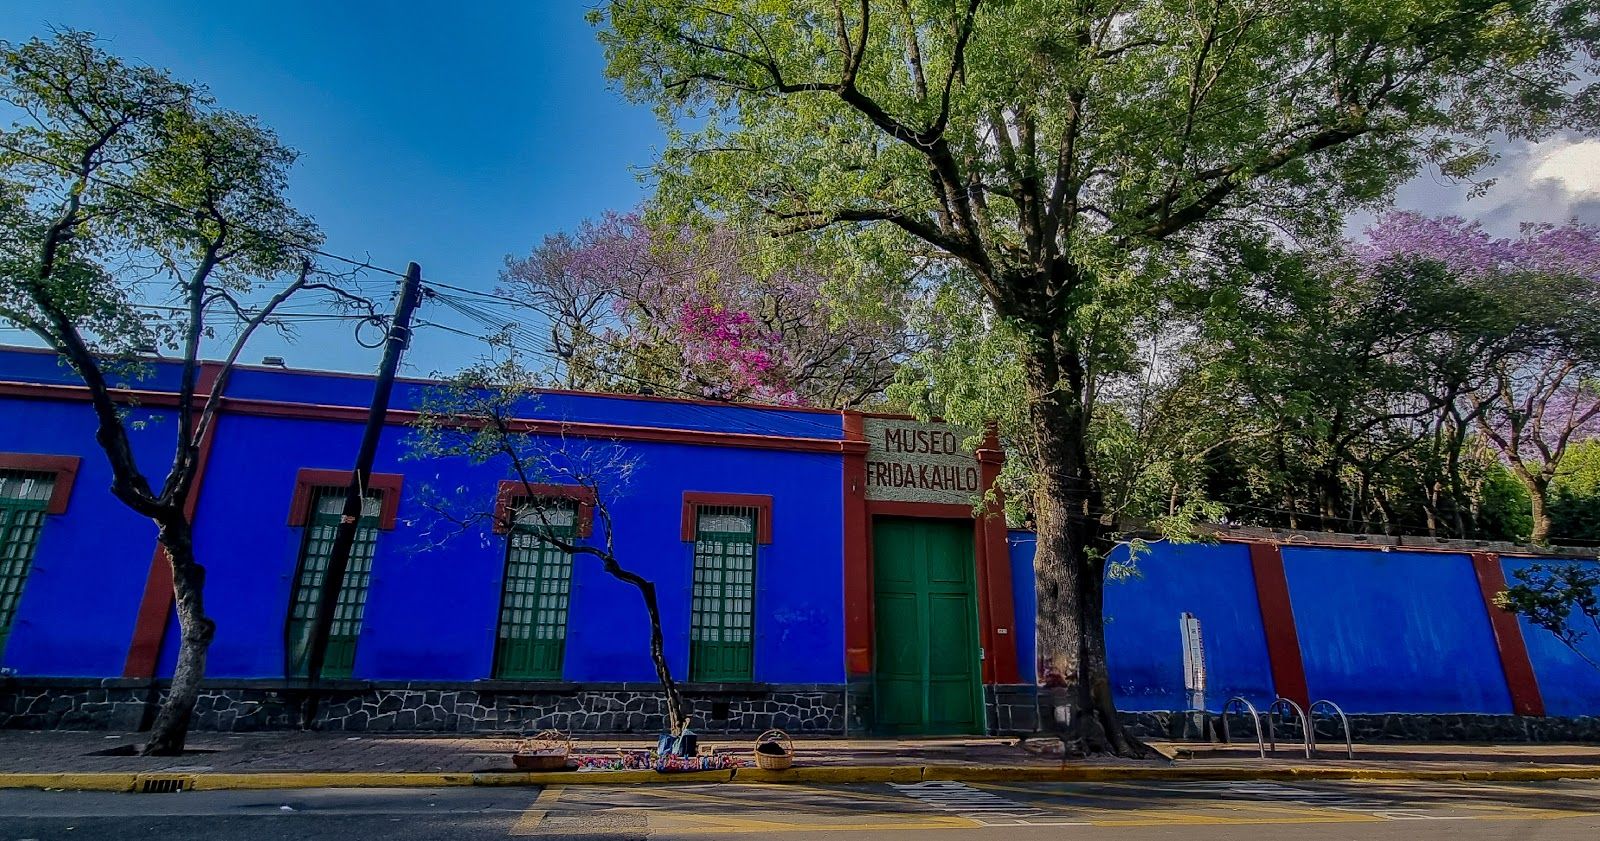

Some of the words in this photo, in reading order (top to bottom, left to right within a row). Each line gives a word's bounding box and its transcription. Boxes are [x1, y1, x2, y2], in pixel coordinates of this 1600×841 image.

[885, 428, 957, 455] MUSEO
[866, 461, 915, 488] FRIDA
[919, 464, 978, 492] KAHLO
